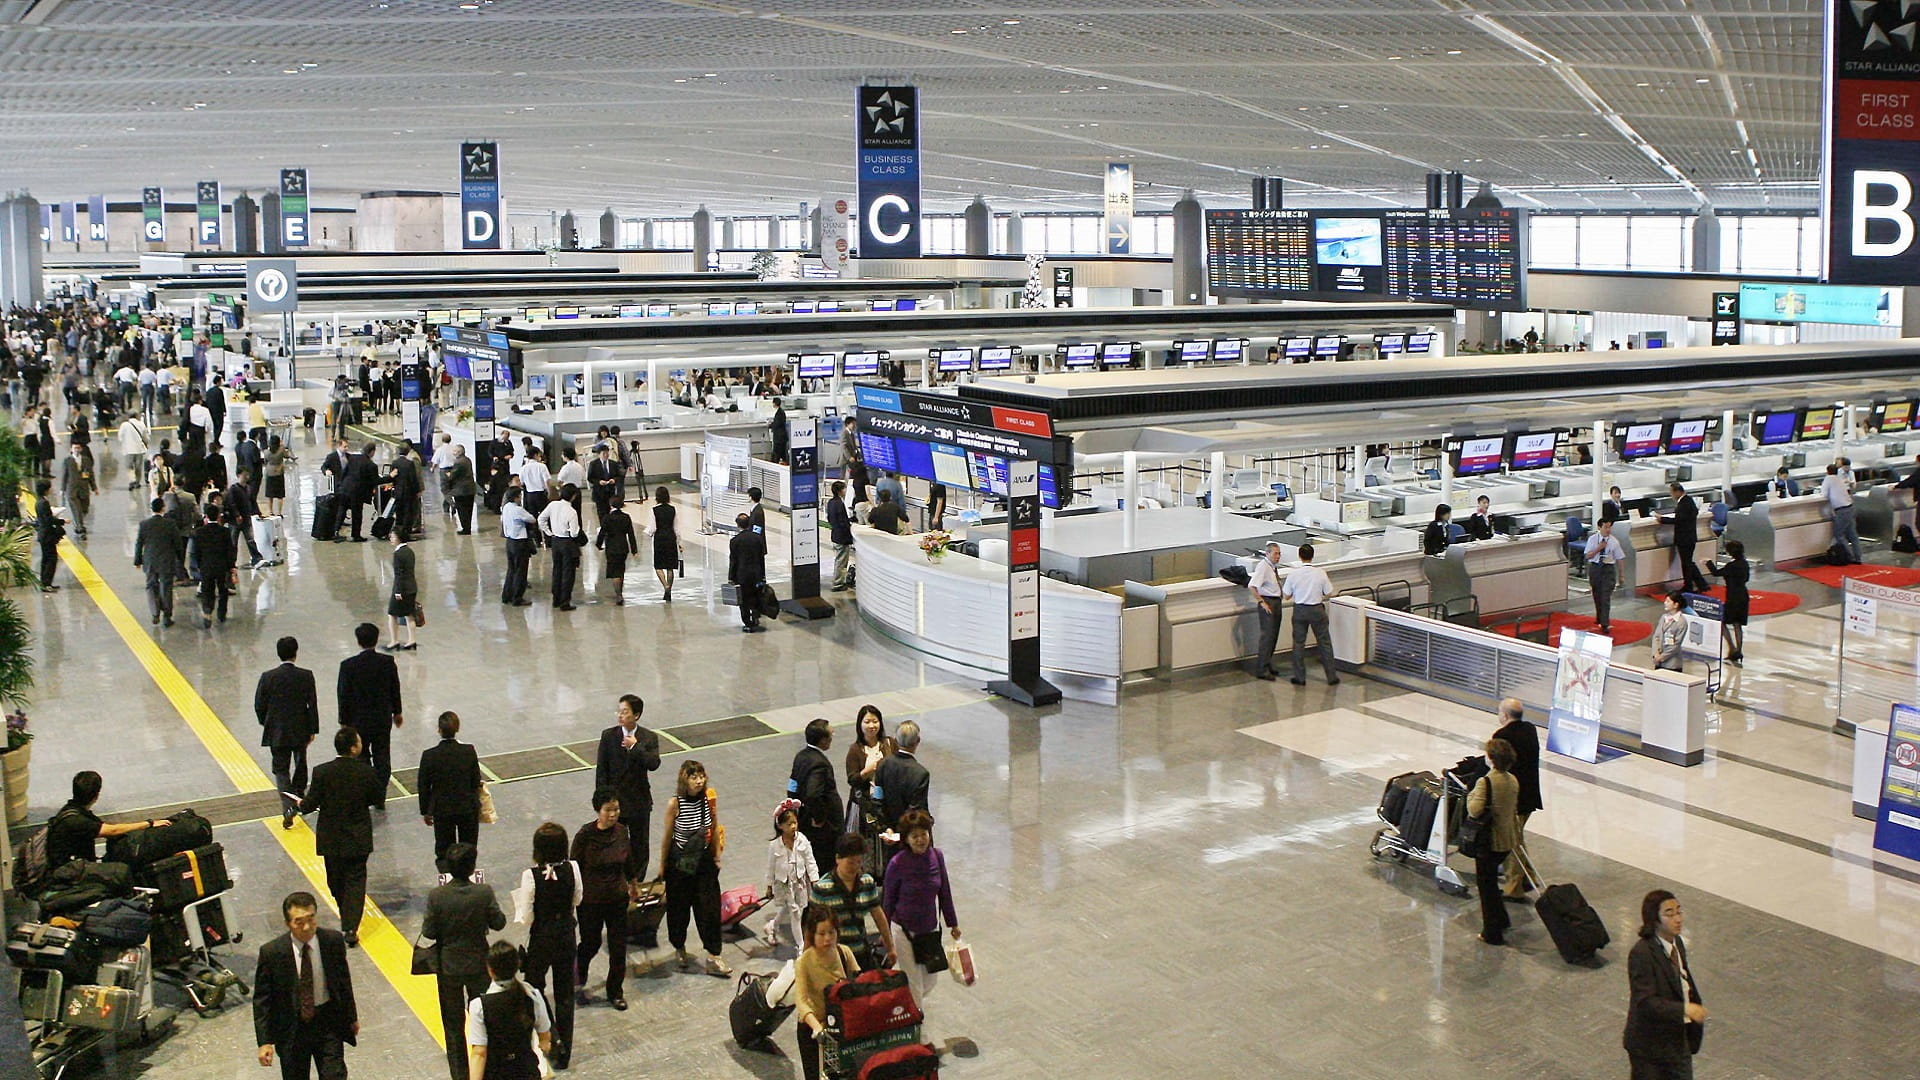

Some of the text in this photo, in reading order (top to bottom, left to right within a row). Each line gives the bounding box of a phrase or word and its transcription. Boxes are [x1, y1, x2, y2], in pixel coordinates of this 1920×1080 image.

[1845, 61, 1872, 70] STAR
[1861, 94, 1910, 108] FIRST
[1856, 113, 1914, 128] CLASS
[864, 155, 913, 164] BUSINESS
[872, 166, 906, 174] CLASS
[1108, 192, 1129, 204] 出発
[868, 194, 911, 244] C
[1852, 170, 1916, 257] B
[90, 223, 105, 239] H
[145, 221, 162, 239] G
[202, 221, 217, 241] F
[286, 217, 305, 241] E
[467, 210, 494, 241] D
[918, 402, 961, 416] STAR ALLIANCE
[870, 416, 932, 435] チェックインカウンター
[1852, 582, 1876, 594] FIRST
[1878, 588, 1912, 602] CLASS
[888, 1032, 912, 1043] JAPAN
